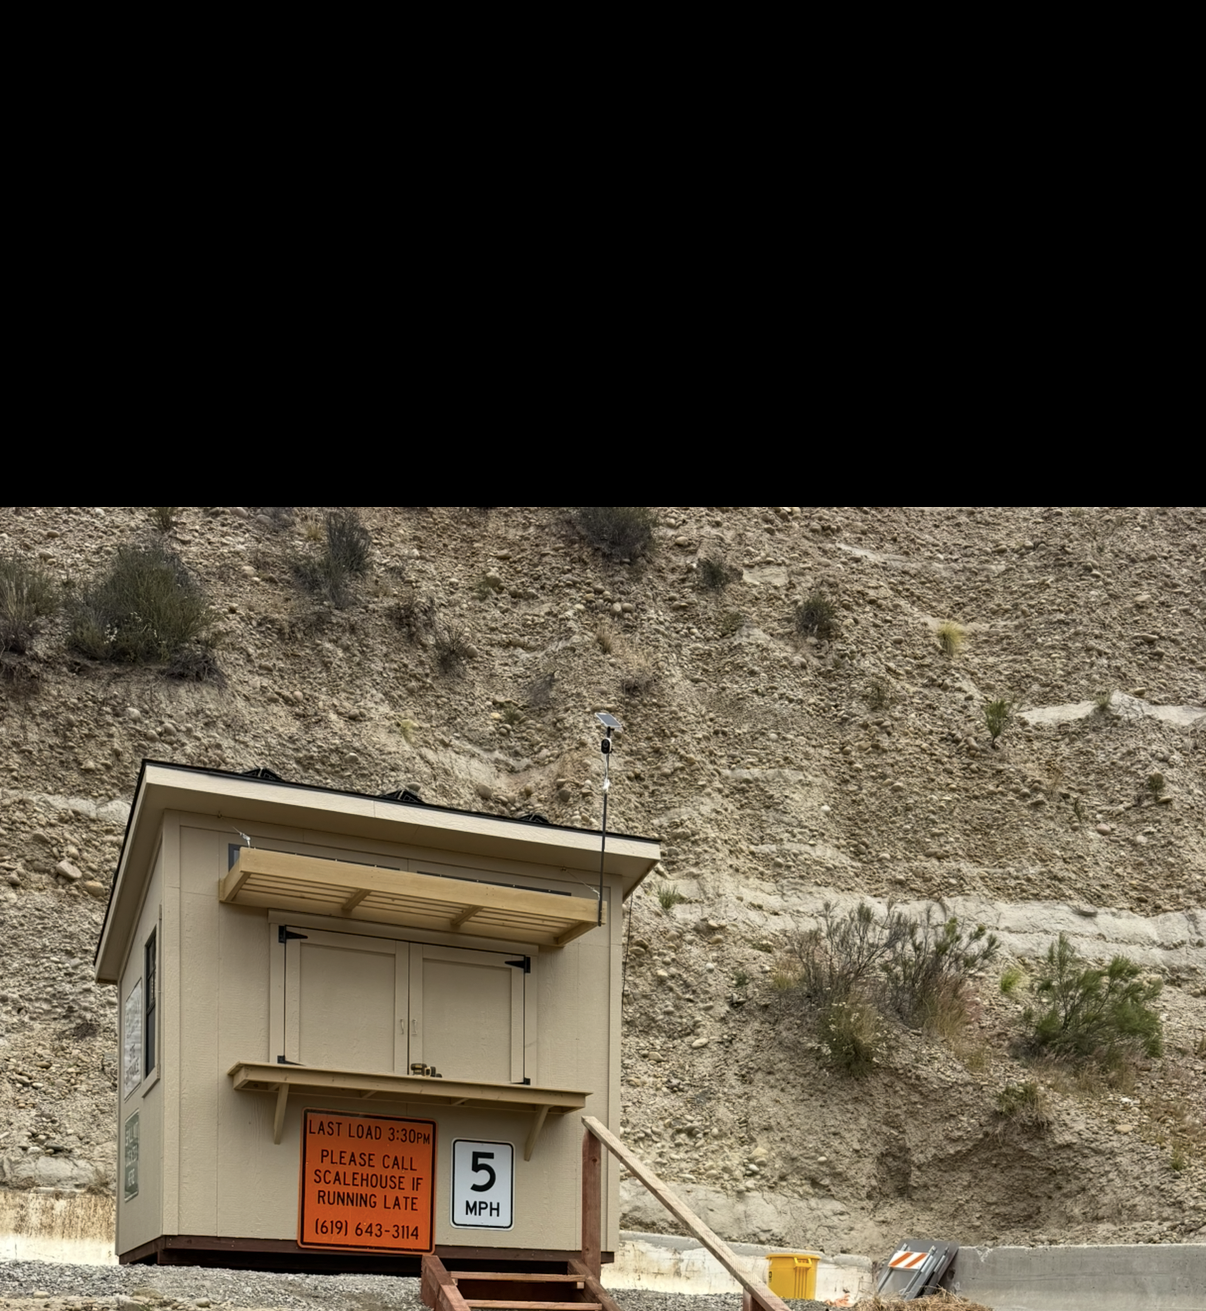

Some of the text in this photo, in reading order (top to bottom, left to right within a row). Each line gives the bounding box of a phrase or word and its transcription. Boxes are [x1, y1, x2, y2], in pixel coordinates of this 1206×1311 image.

[309, 1119, 431, 1145] LAST LOAD 3:30PM
[320, 1149, 417, 1171] PLEASE CALL
[313, 1169, 424, 1192] SCALEHOUSE IF
[470, 1151, 496, 1192] 5
[317, 1190, 419, 1211] RUNNING LATE
[465, 1200, 500, 1217] MPH
[315, 1218, 420, 1240] (619) 643-3114
